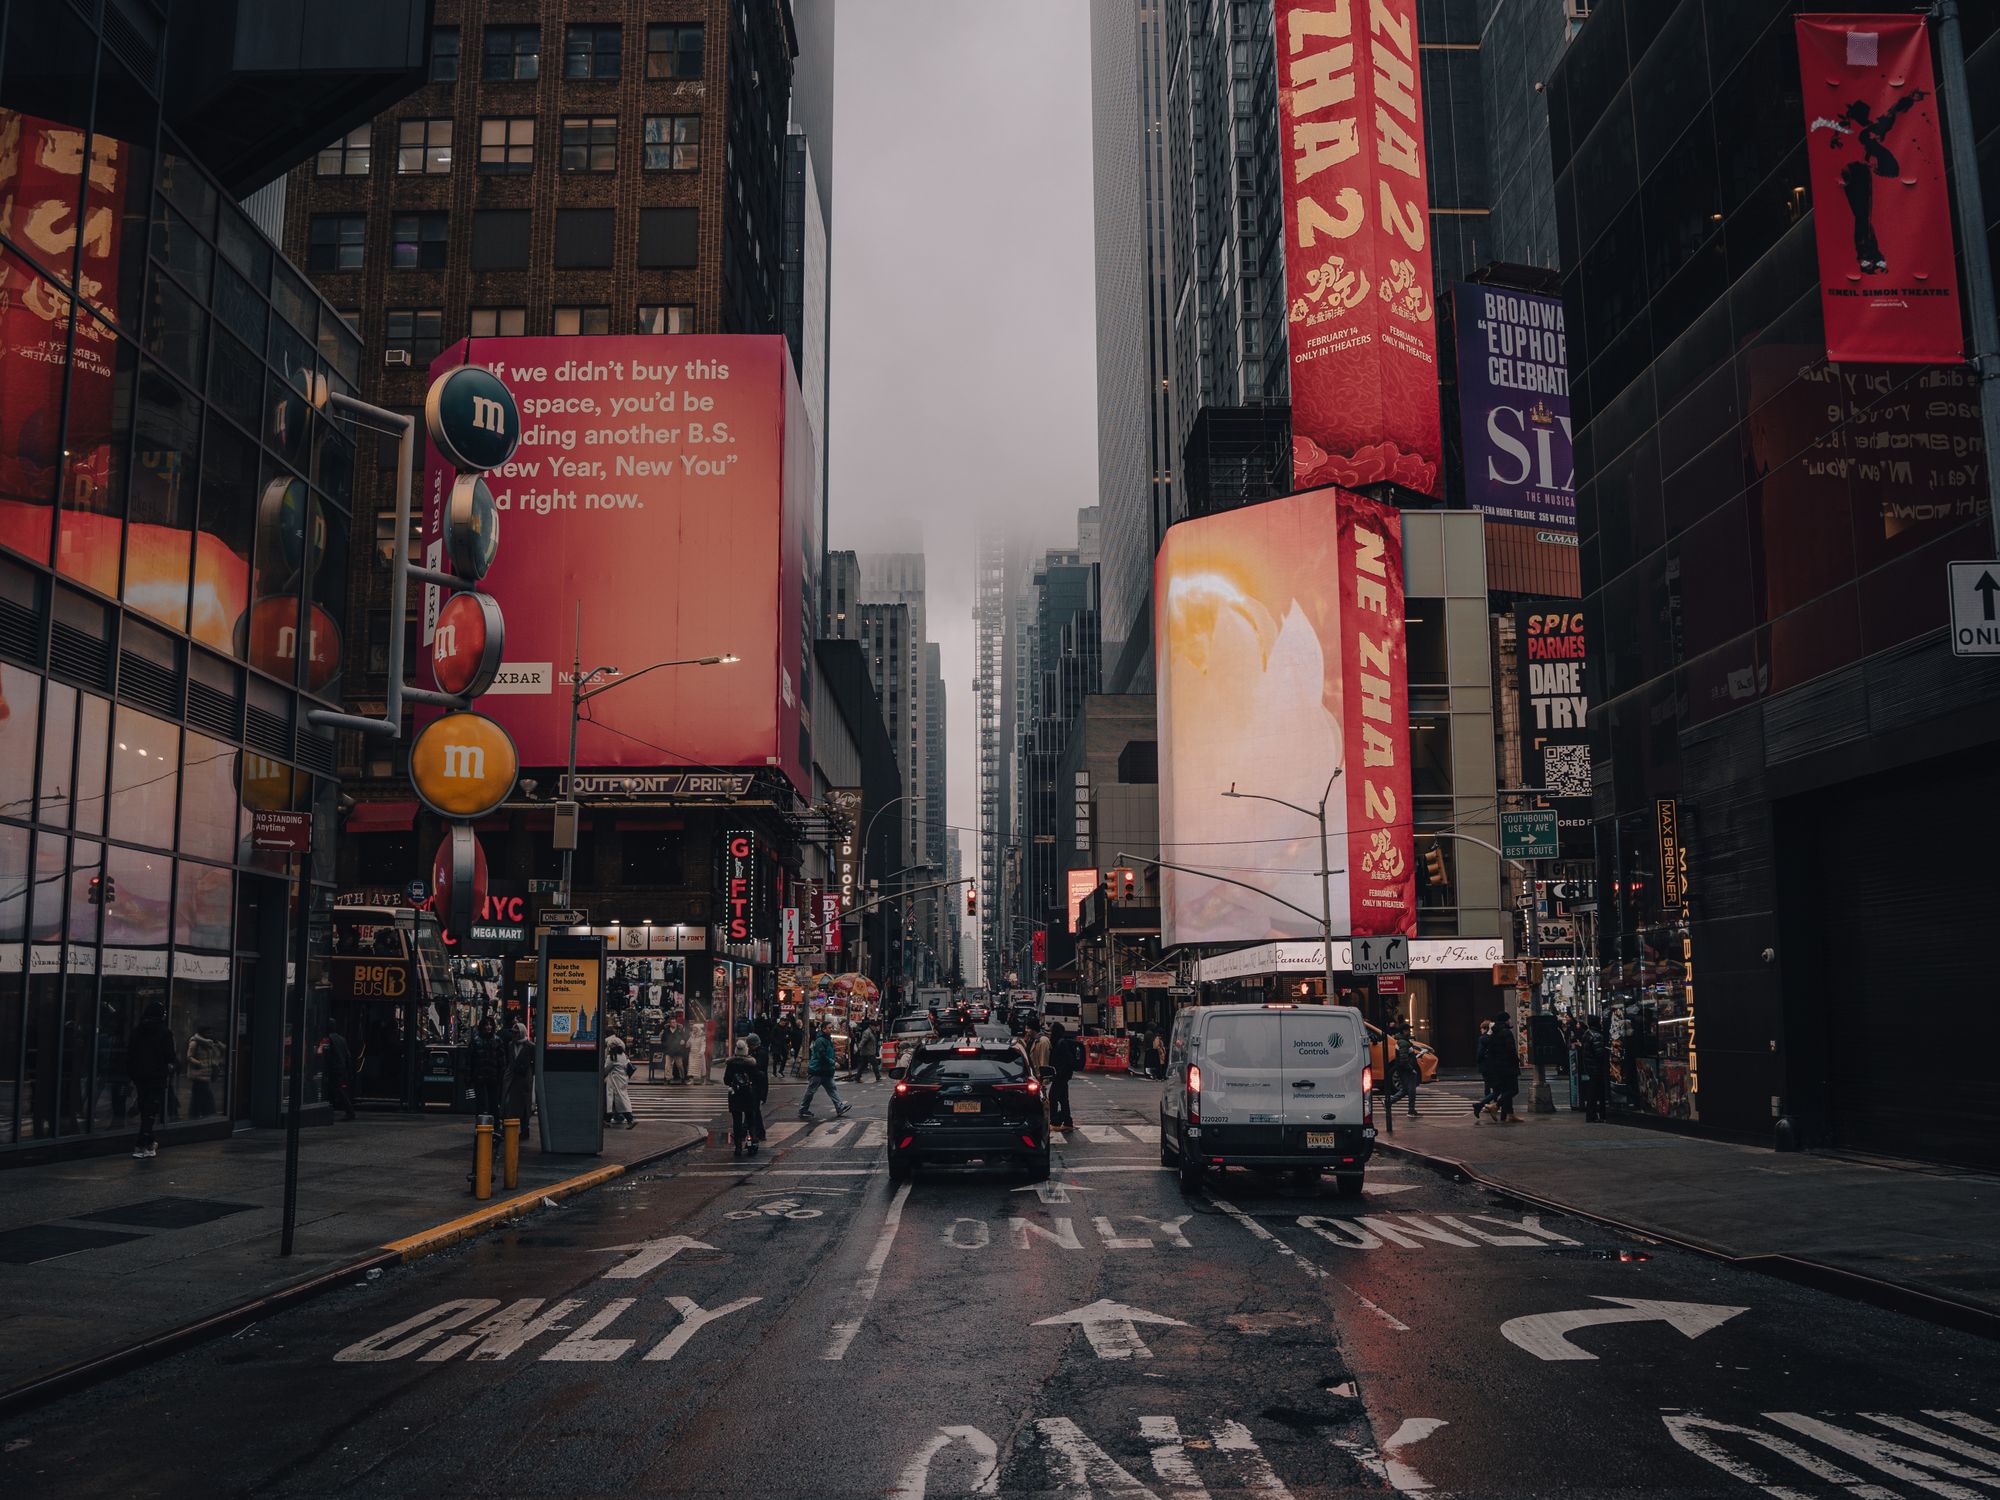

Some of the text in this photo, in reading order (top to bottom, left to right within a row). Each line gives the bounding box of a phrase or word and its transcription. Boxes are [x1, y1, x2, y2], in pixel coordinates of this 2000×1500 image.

[1297, 188, 1364, 248] 2
[1379, 179, 1425, 251] 2
[1836, 288, 1859, 296] NEIL
[1862, 288, 1898, 296] SIMON
[1902, 288, 1950, 296] THEATRE
[1307, 327, 1358, 348] FEBRUARY 14
[1381, 333, 1432, 363] ONLY IN THEATERS
[1390, 325, 1424, 348] FEBRUARY 14
[1295, 334, 1371, 363] ONLY IN THEATERS
[511, 365, 547, 382] we
[631, 360, 678, 385] buy
[685, 358, 729, 380] this
[472, 394, 505, 434] m
[523, 396, 602, 418] space,
[683, 391, 714, 412] be
[584, 425, 680, 446] another
[688, 423, 735, 443] B.S.
[548, 456, 607, 480] Year,
[616, 455, 672, 476] New
[520, 490, 576, 515] right
[585, 493, 644, 510] now.
[1526, 491, 1575, 507] THE MUSICA
[1514, 509, 1536, 520] THEATRE
[428, 557, 438, 629] RXBR
[1527, 612, 1585, 635] SPIC
[435, 624, 456, 660] m
[1527, 635, 1586, 660] PARMES
[492, 673, 541, 684] XBAR
[1354, 523, 1397, 824] NE ZHA 2
[1529, 662, 1581, 695] DARE
[1531, 696, 1588, 729] TRY
[443, 745, 485, 779] m
[573, 777, 670, 792] OUTFONT
[256, 813, 302, 824] NO STANDING
[256, 823, 286, 832] Anytime
[1503, 813, 1554, 823] SOUTHBOUND
[1508, 823, 1550, 833] USE 7 AVE
[1506, 846, 1553, 856] BEST ROUTE
[1661, 803, 1677, 903] MAX BRENNER
[730, 838, 750, 938] GFTS
[842, 864, 852, 906] ROCK
[1369, 889, 1392, 897] FEBRUARY
[372, 893, 401, 905] AVE
[1382, 900, 1405, 909] THEATERS
[473, 928, 522, 939] MEGA MART
[786, 909, 795, 963] PZZA
[355, 965, 383, 981] BIG
[1355, 961, 1407, 971] ONLY ONLY
[353, 981, 382, 996] BUS
[563, 978, 586, 986] housing
[1682, 938, 1698, 1094] BRENNER
[1293, 1039, 1323, 1048] Johnson
[1298, 1047, 1329, 1056] Controls
[1293, 1092, 1345, 1100] johnsoncontrols.com
[943, 1214, 1195, 1250] ONLY
[1295, 1214, 1584, 1250] ONLY
[333, 1296, 764, 1362] ONLY
